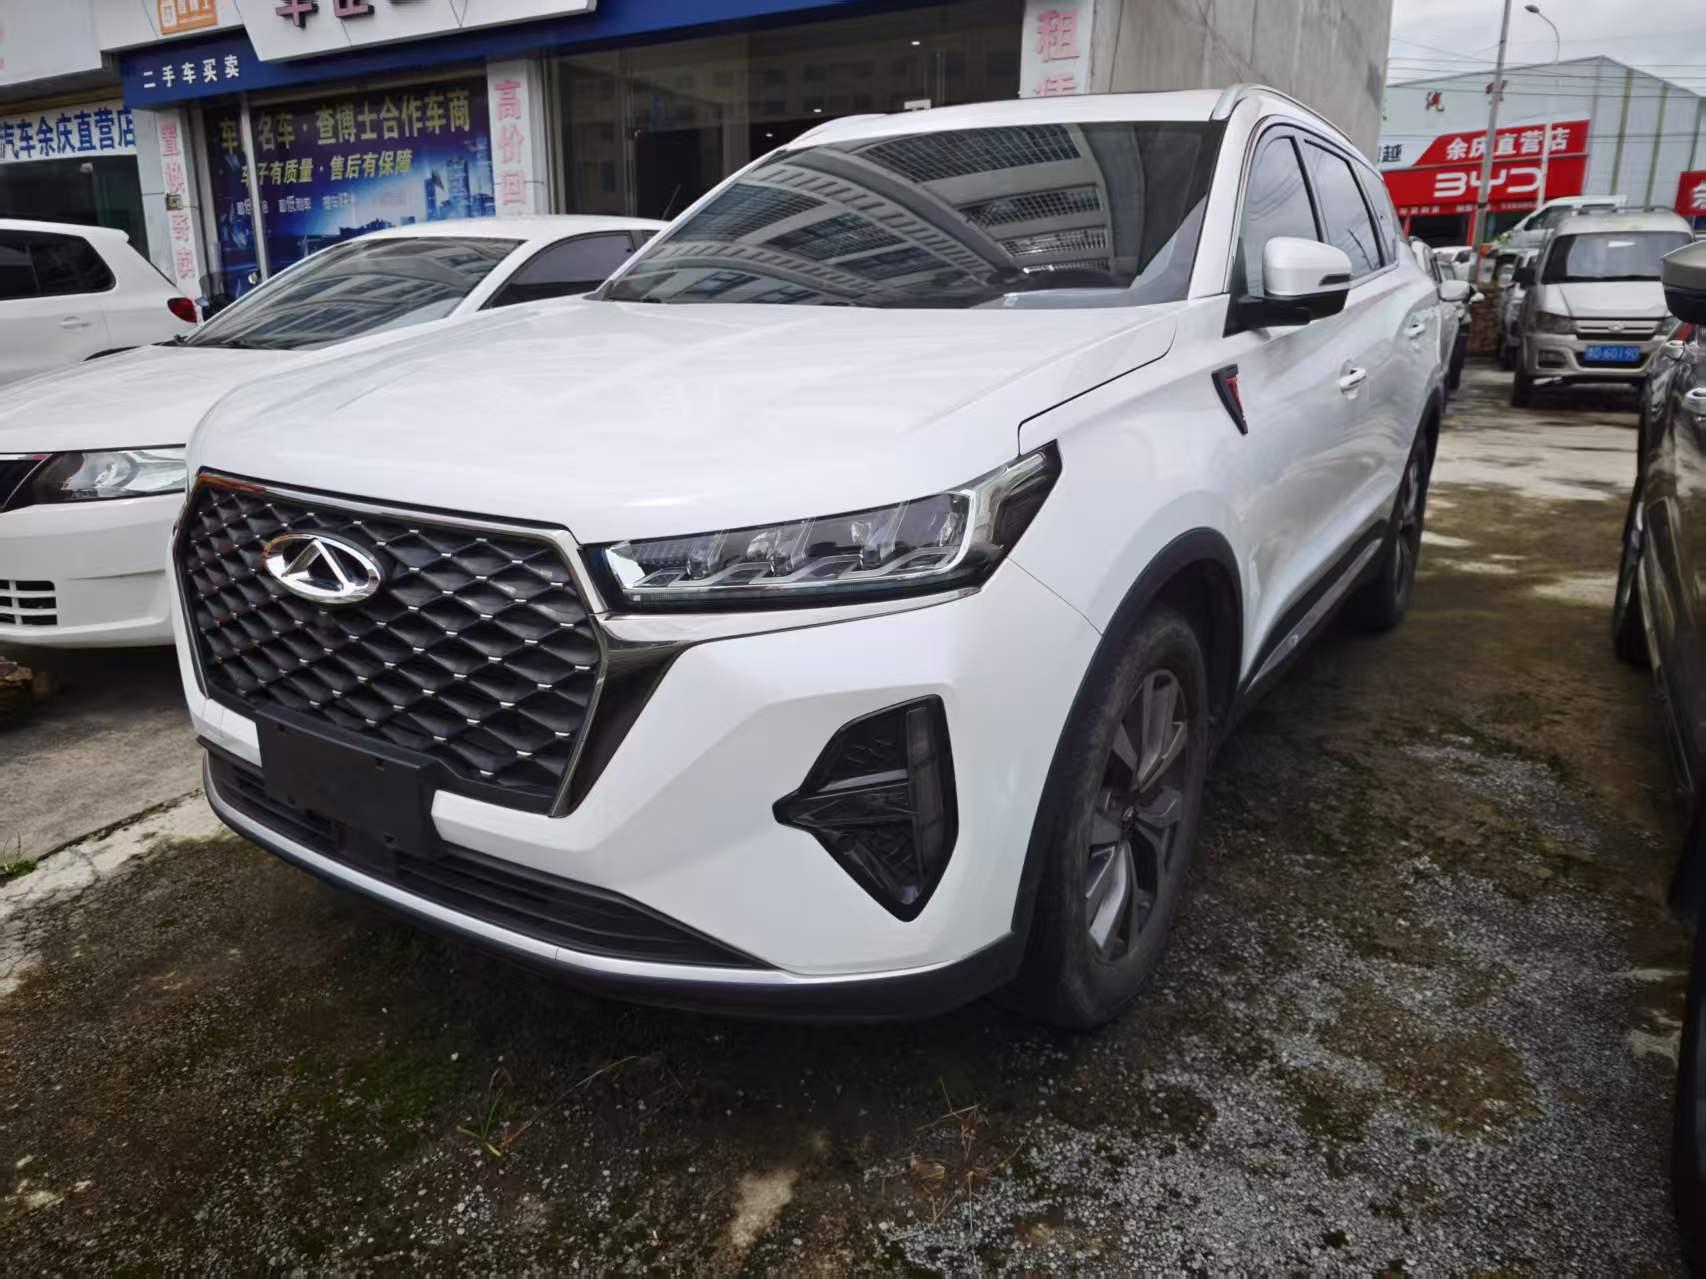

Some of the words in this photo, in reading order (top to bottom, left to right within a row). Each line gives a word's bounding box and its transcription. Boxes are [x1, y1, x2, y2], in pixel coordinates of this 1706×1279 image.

[143, 54, 240, 88] 二手车买卖
[0, 104, 136, 160] 汽车余庆直营店
[220, 90, 470, 154] 车名车·查博士合作车商
[1377, 144, 1402, 163] 越
[1433, 166, 1541, 198] BYD
